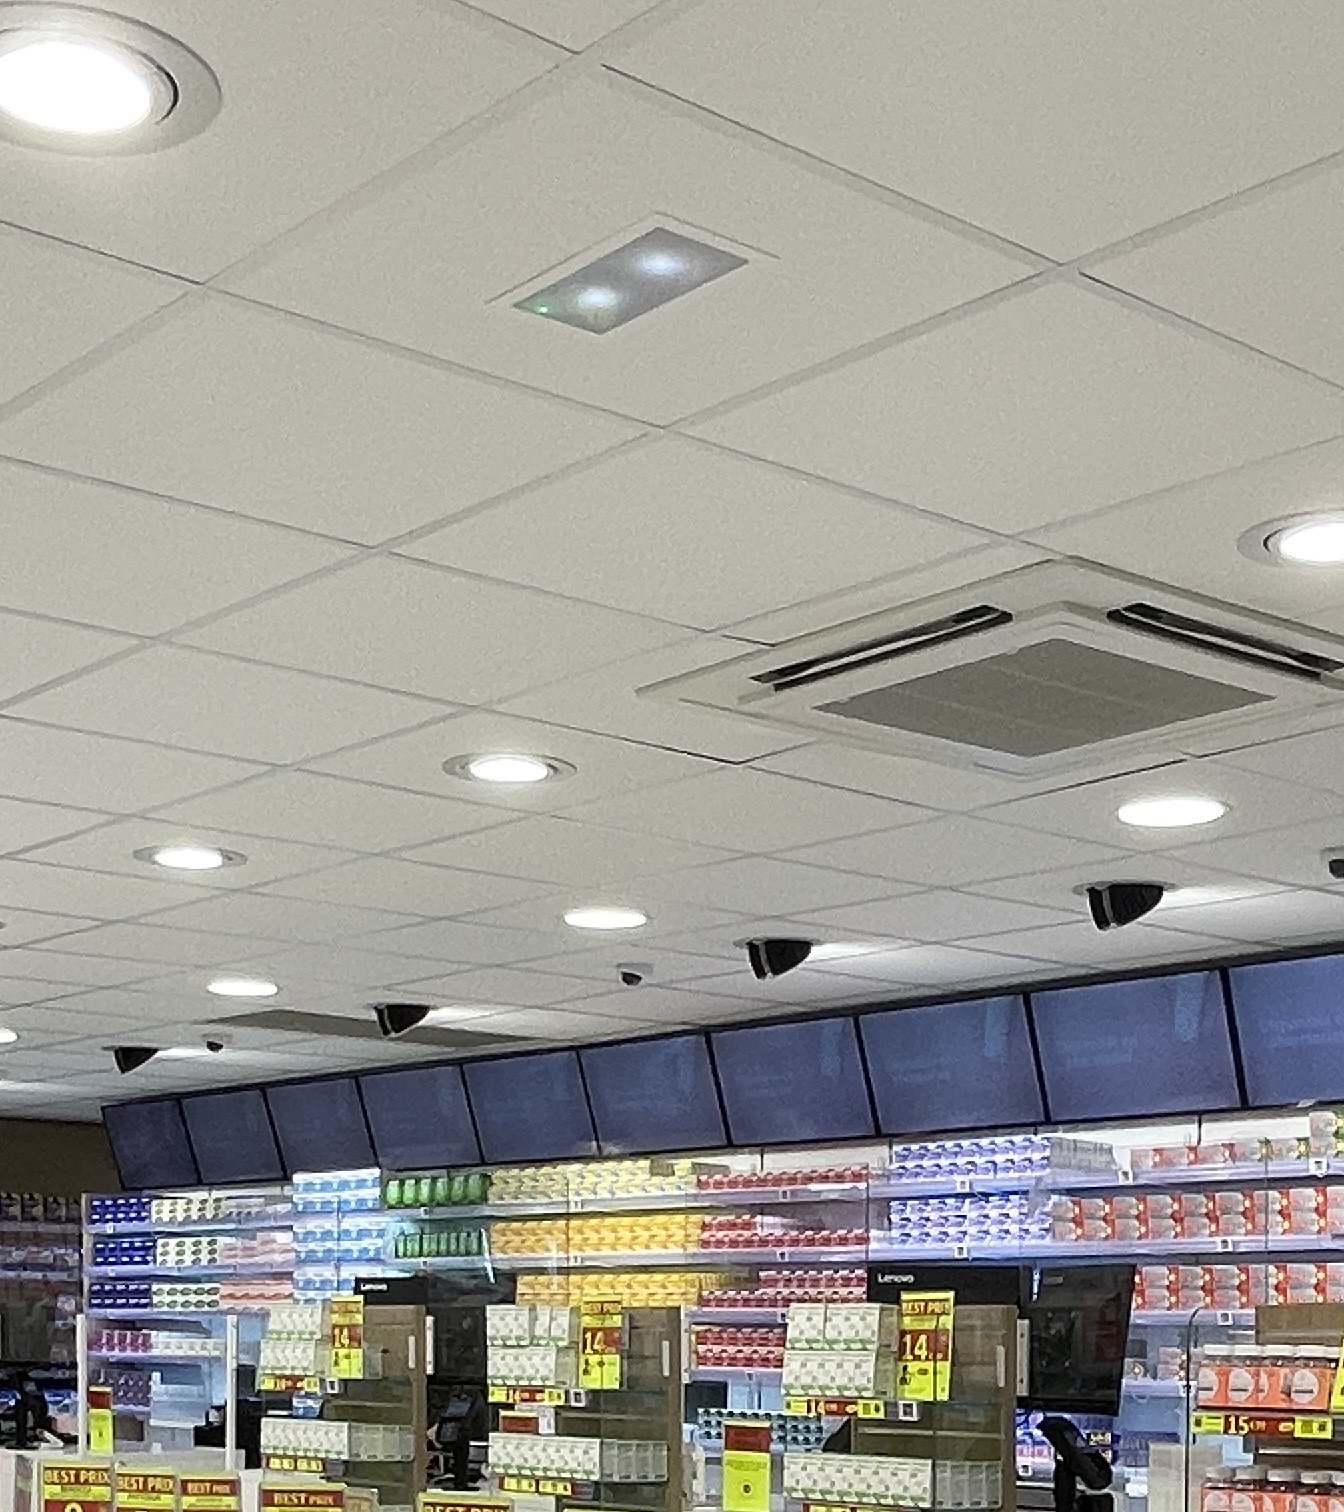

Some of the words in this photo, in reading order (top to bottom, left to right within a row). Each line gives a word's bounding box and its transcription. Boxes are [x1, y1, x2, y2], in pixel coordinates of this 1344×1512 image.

[878, 1273, 915, 1283] Lenovo
[584, 1331, 606, 1354] 14
[902, 1334, 928, 1361] 14
[1228, 1416, 1250, 1435] 15
